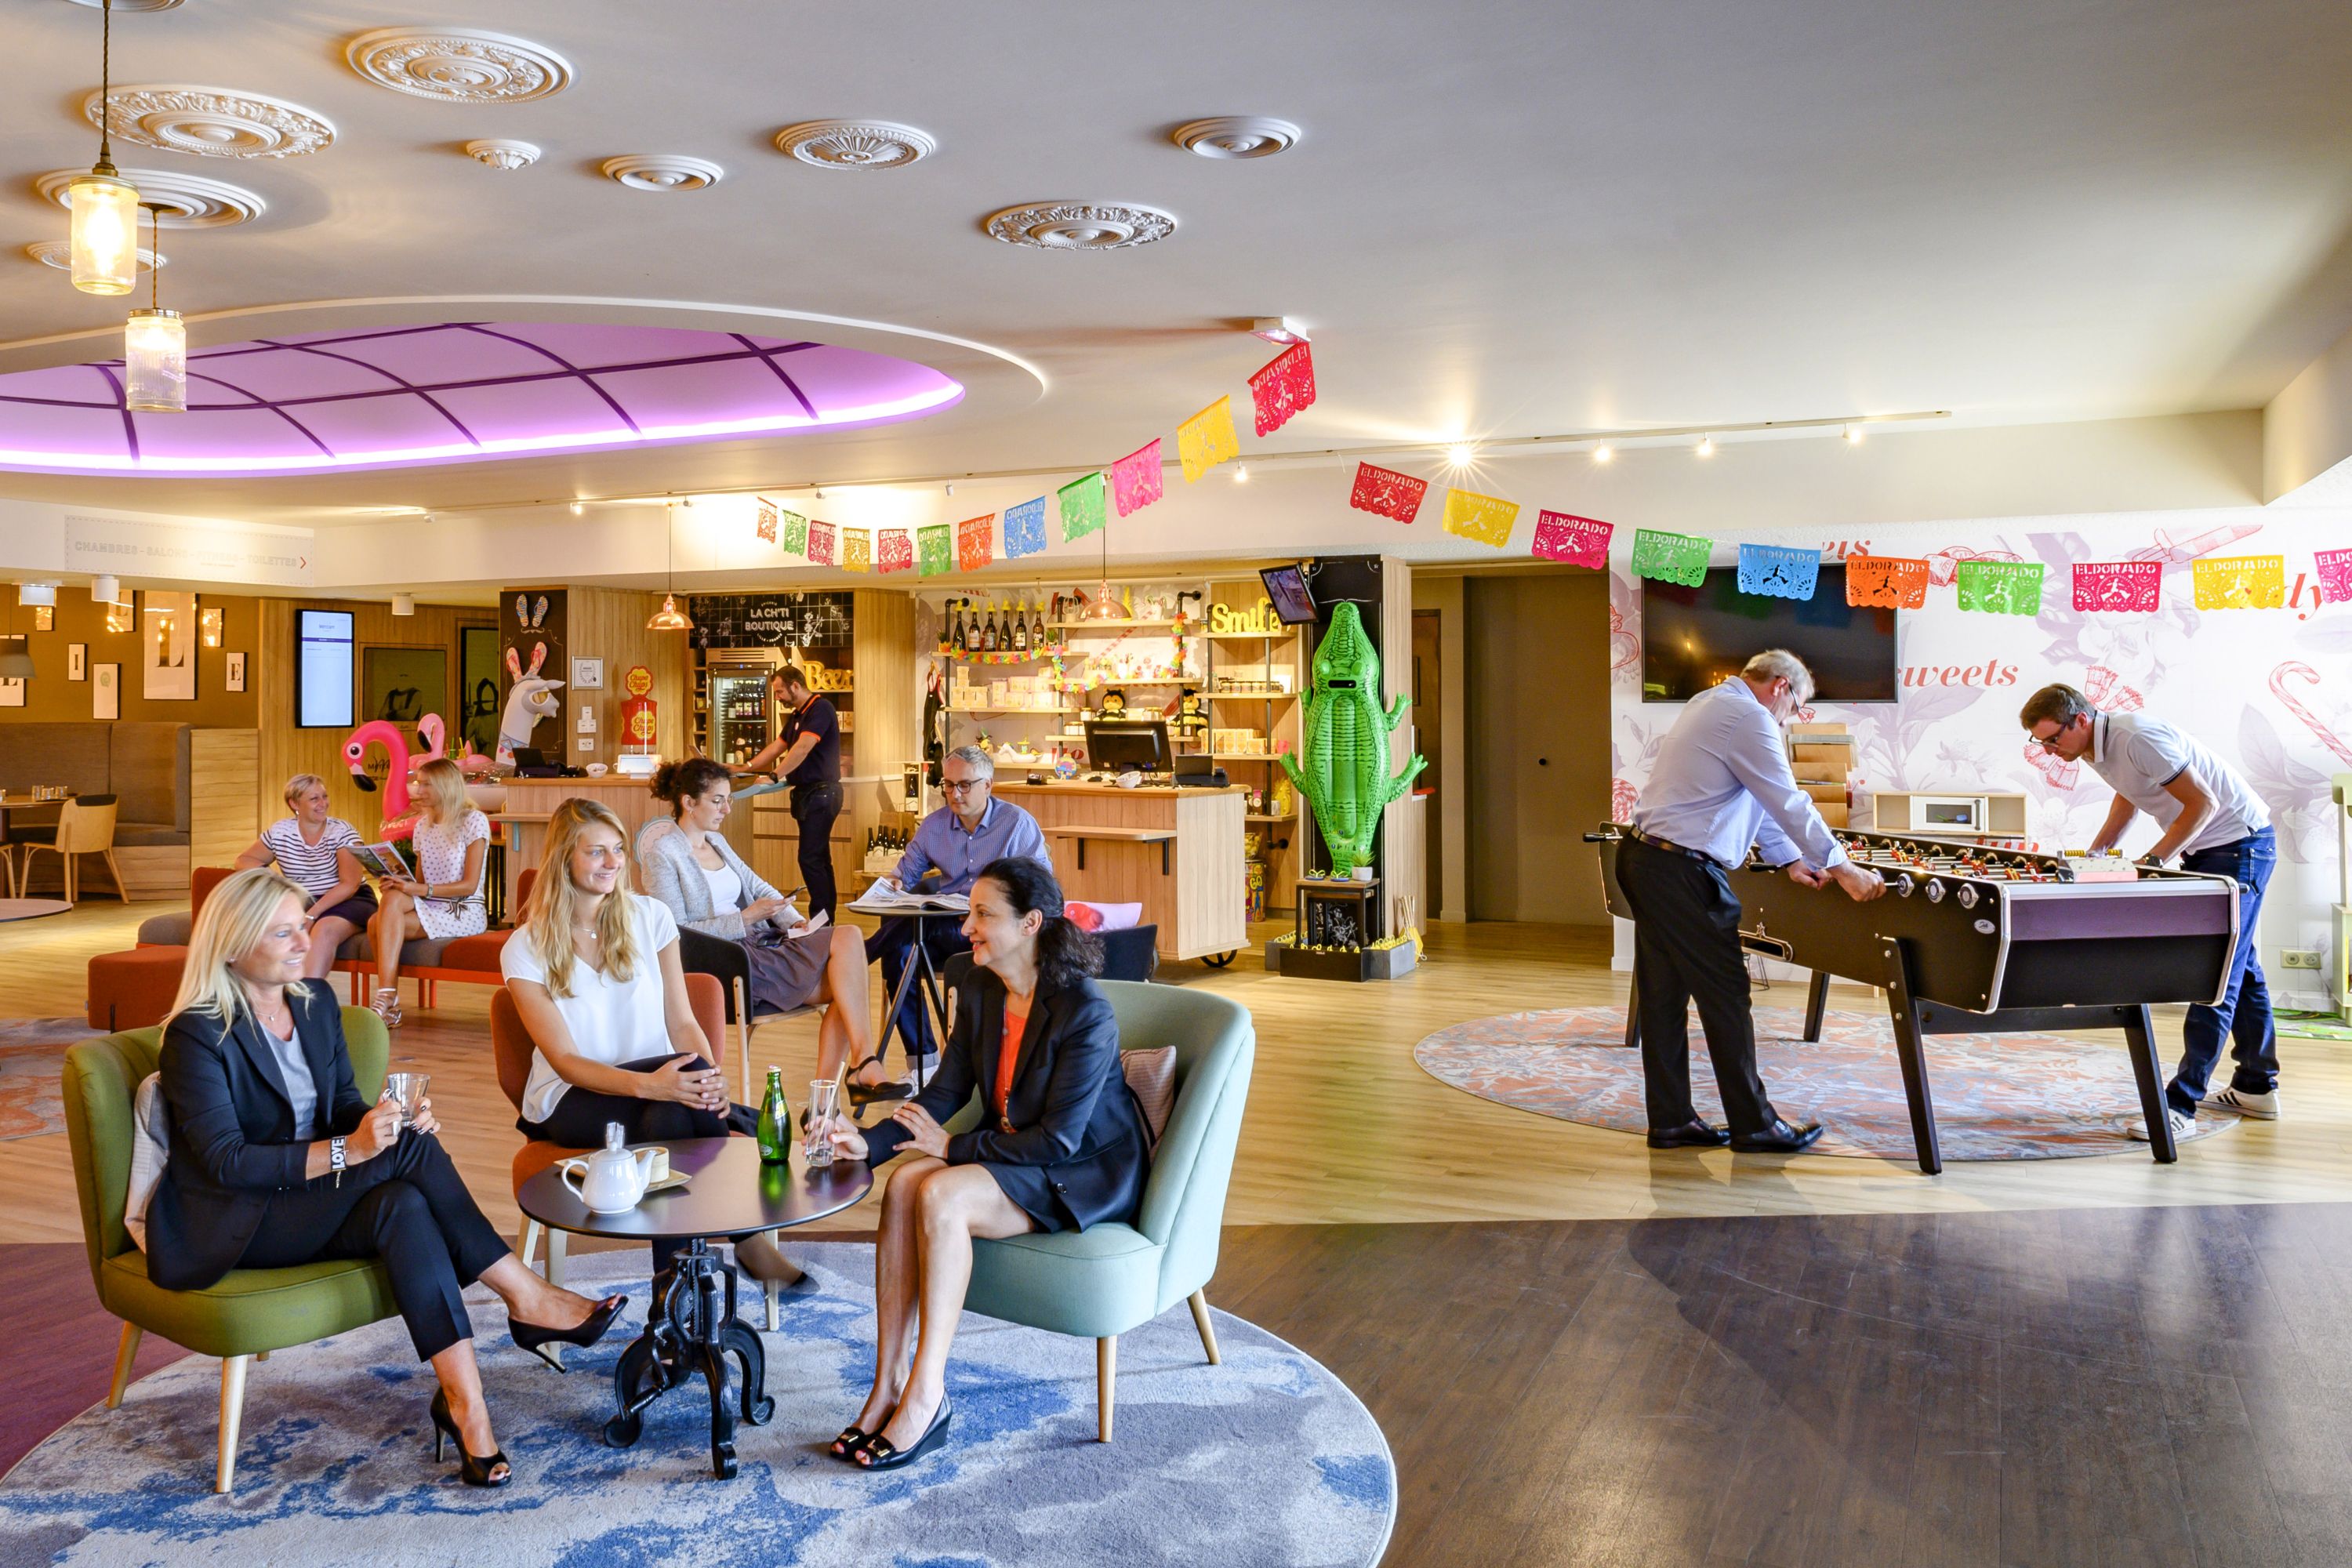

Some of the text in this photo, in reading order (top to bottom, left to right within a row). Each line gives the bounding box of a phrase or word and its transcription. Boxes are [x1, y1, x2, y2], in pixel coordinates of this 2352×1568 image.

[1361, 466, 1423, 492] ELDORADO
[1541, 514, 1609, 536] ELDORADO
[1638, 531, 1708, 551] ELDORADO
[74, 540, 138, 556] CHAMBRES
[246, 554, 296, 567] TOILETTES
[1743, 547, 1817, 564] ELDORADO
[1851, 560, 1926, 572] ELDORADO
[1962, 564, 2039, 579] ELDORADO
[2075, 563, 2156, 575] ELDORADO
[2196, 559, 2278, 573] ELDORADO
[750, 608, 789, 619] LA CH'TI
[745, 616, 794, 633] BOUTIQUE
[629, 681, 649, 690] Chups
[332, 1138, 345, 1169] LOVE
